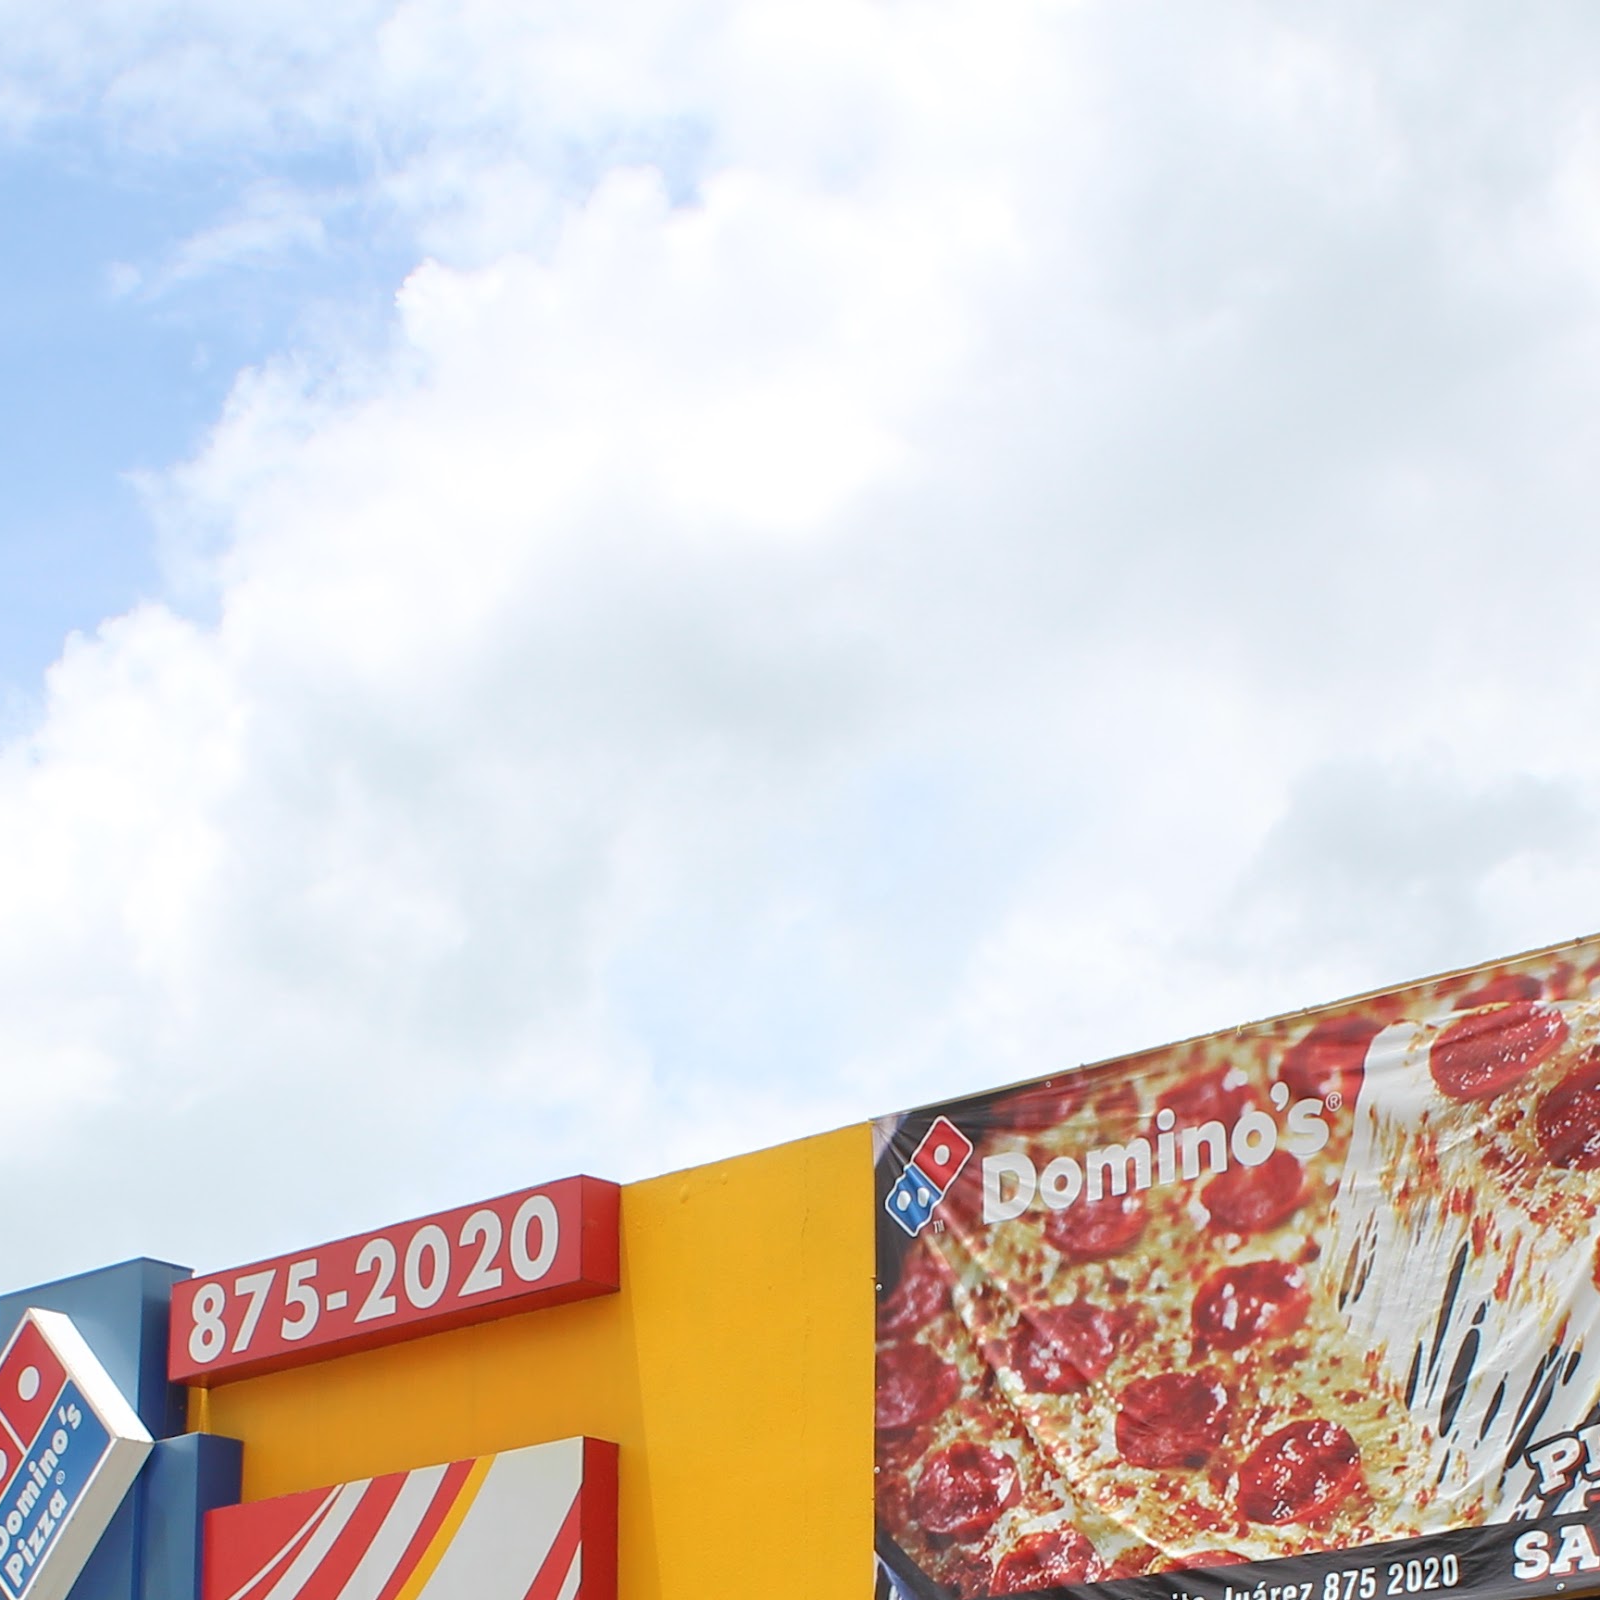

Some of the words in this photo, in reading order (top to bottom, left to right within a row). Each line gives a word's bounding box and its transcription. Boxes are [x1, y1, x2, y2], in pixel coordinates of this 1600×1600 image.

[983, 1081, 1329, 1224] Domino's
[187, 1194, 559, 1363] 875-2020
[4, 1488, 68, 1589] Pizza
[1386, 1553, 1460, 1596] 2020
